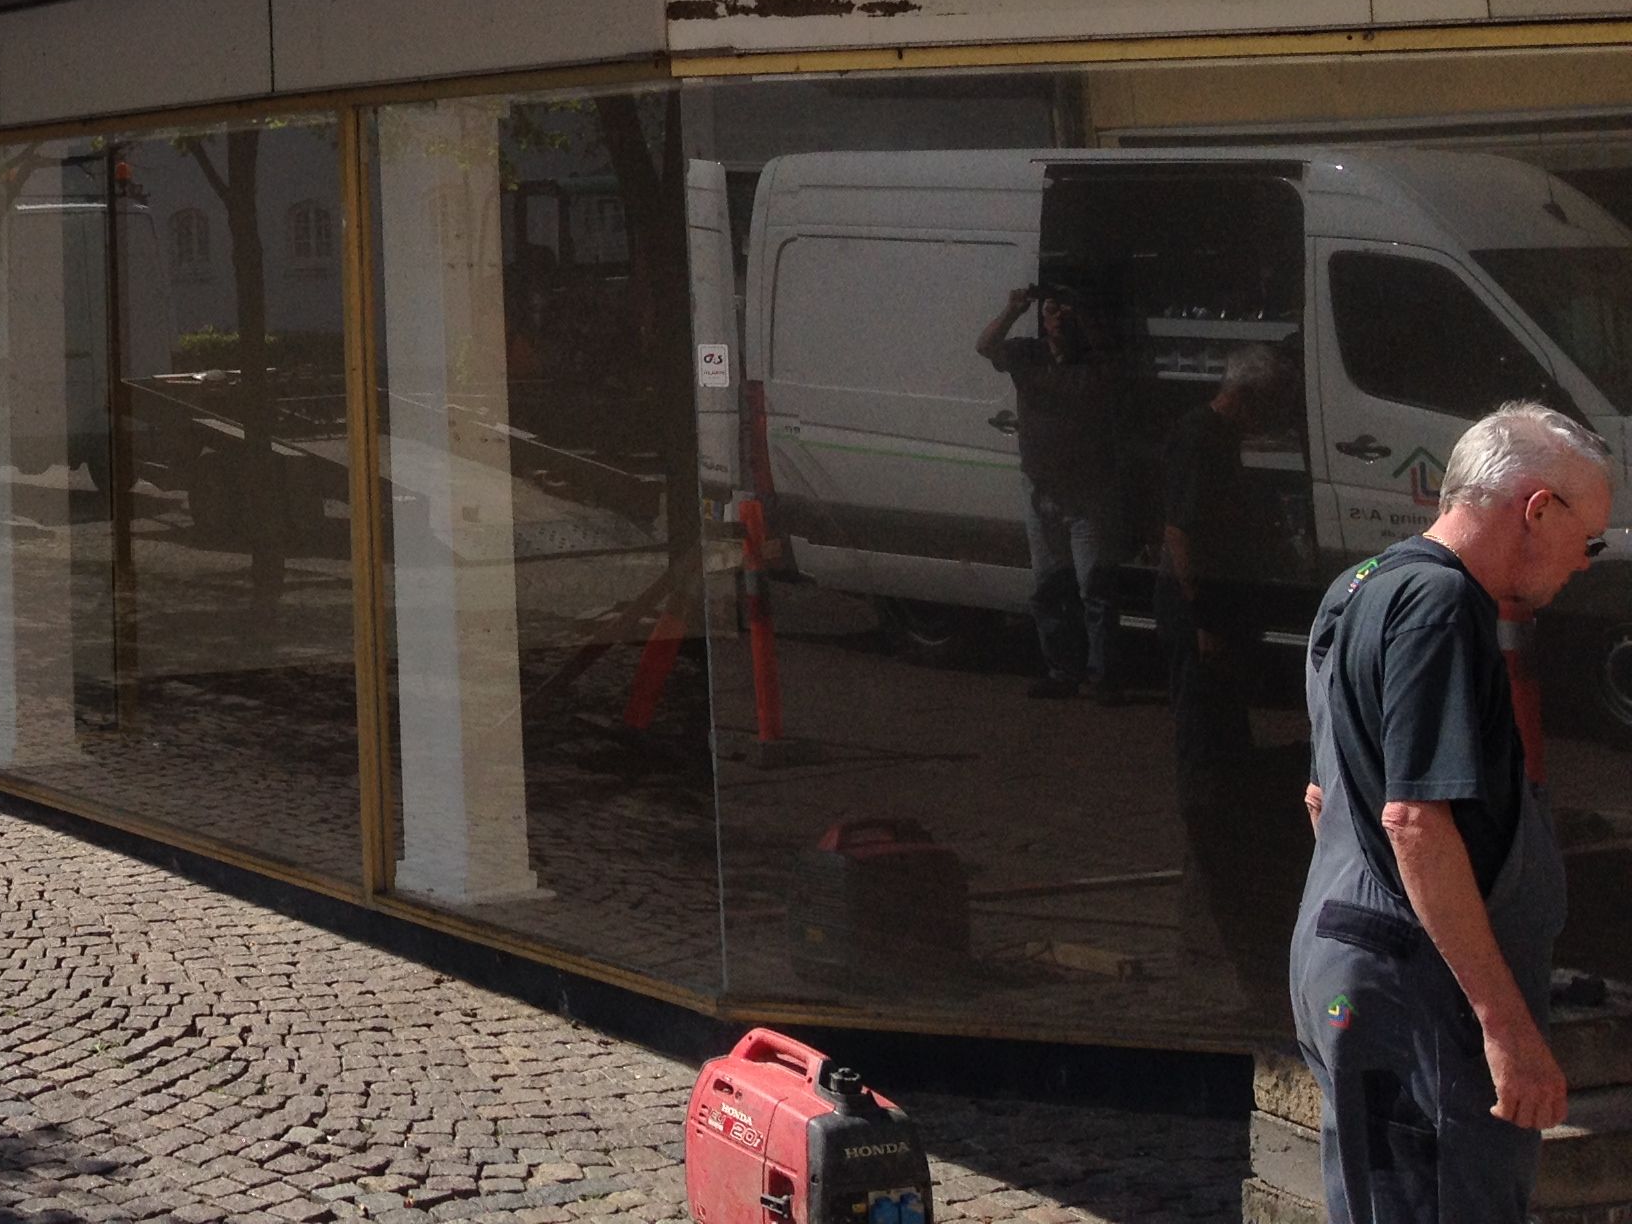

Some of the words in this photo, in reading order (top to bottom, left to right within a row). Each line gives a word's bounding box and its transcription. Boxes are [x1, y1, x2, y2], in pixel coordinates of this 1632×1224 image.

[720, 1102, 753, 1126] HONDA
[730, 1121, 763, 1147] 20i
[843, 1141, 911, 1159] HONDA
